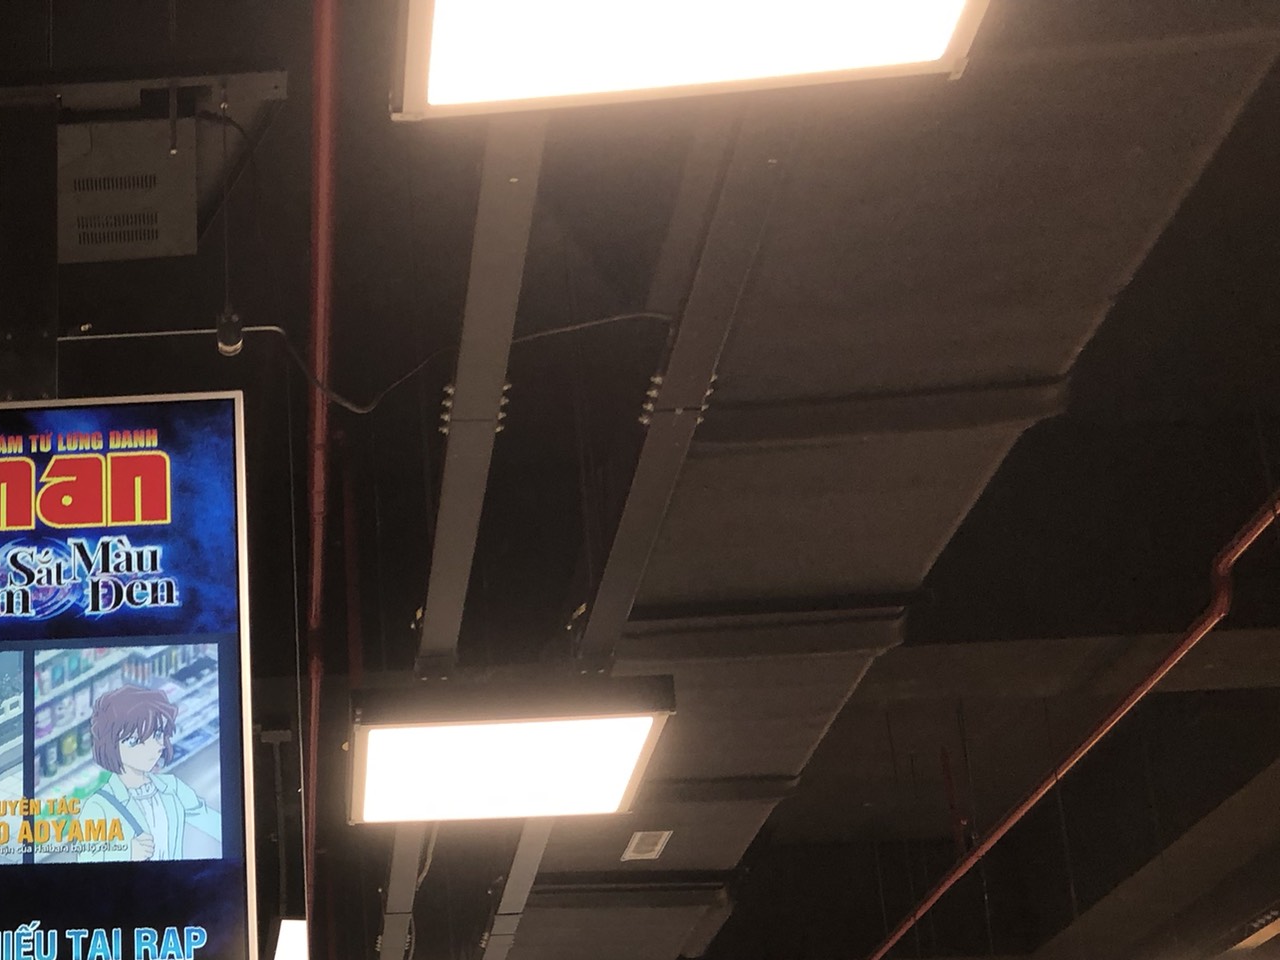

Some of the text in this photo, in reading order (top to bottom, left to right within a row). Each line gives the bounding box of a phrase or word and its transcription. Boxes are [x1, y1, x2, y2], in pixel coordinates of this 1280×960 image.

[109, 428, 158, 449] DANH
[7, 545, 68, 588] Sắt
[68, 536, 162, 582] Màu
[85, 576, 180, 615] Đen
[49, 796, 80, 815] TÁC
[18, 817, 124, 844] AOYAMA
[34, 842, 69, 854] Haibara
